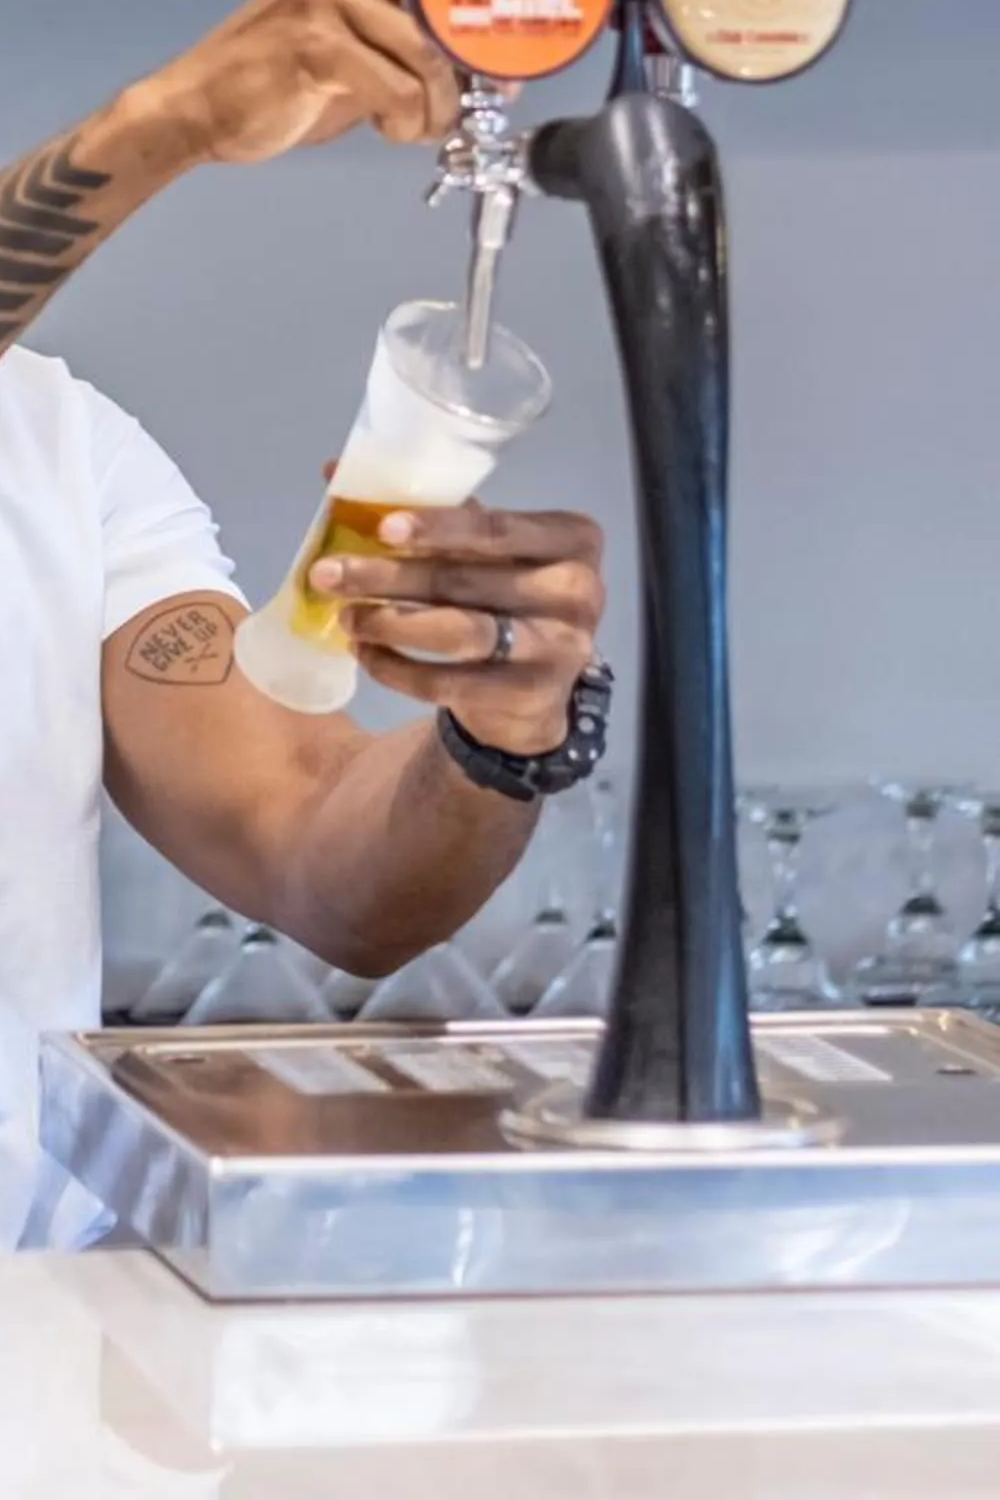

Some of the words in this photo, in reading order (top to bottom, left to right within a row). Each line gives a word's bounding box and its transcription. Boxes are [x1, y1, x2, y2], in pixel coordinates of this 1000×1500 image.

[140, 610, 208, 663] NEVER
[152, 637, 194, 672] GIVE
[193, 622, 217, 642] UP
